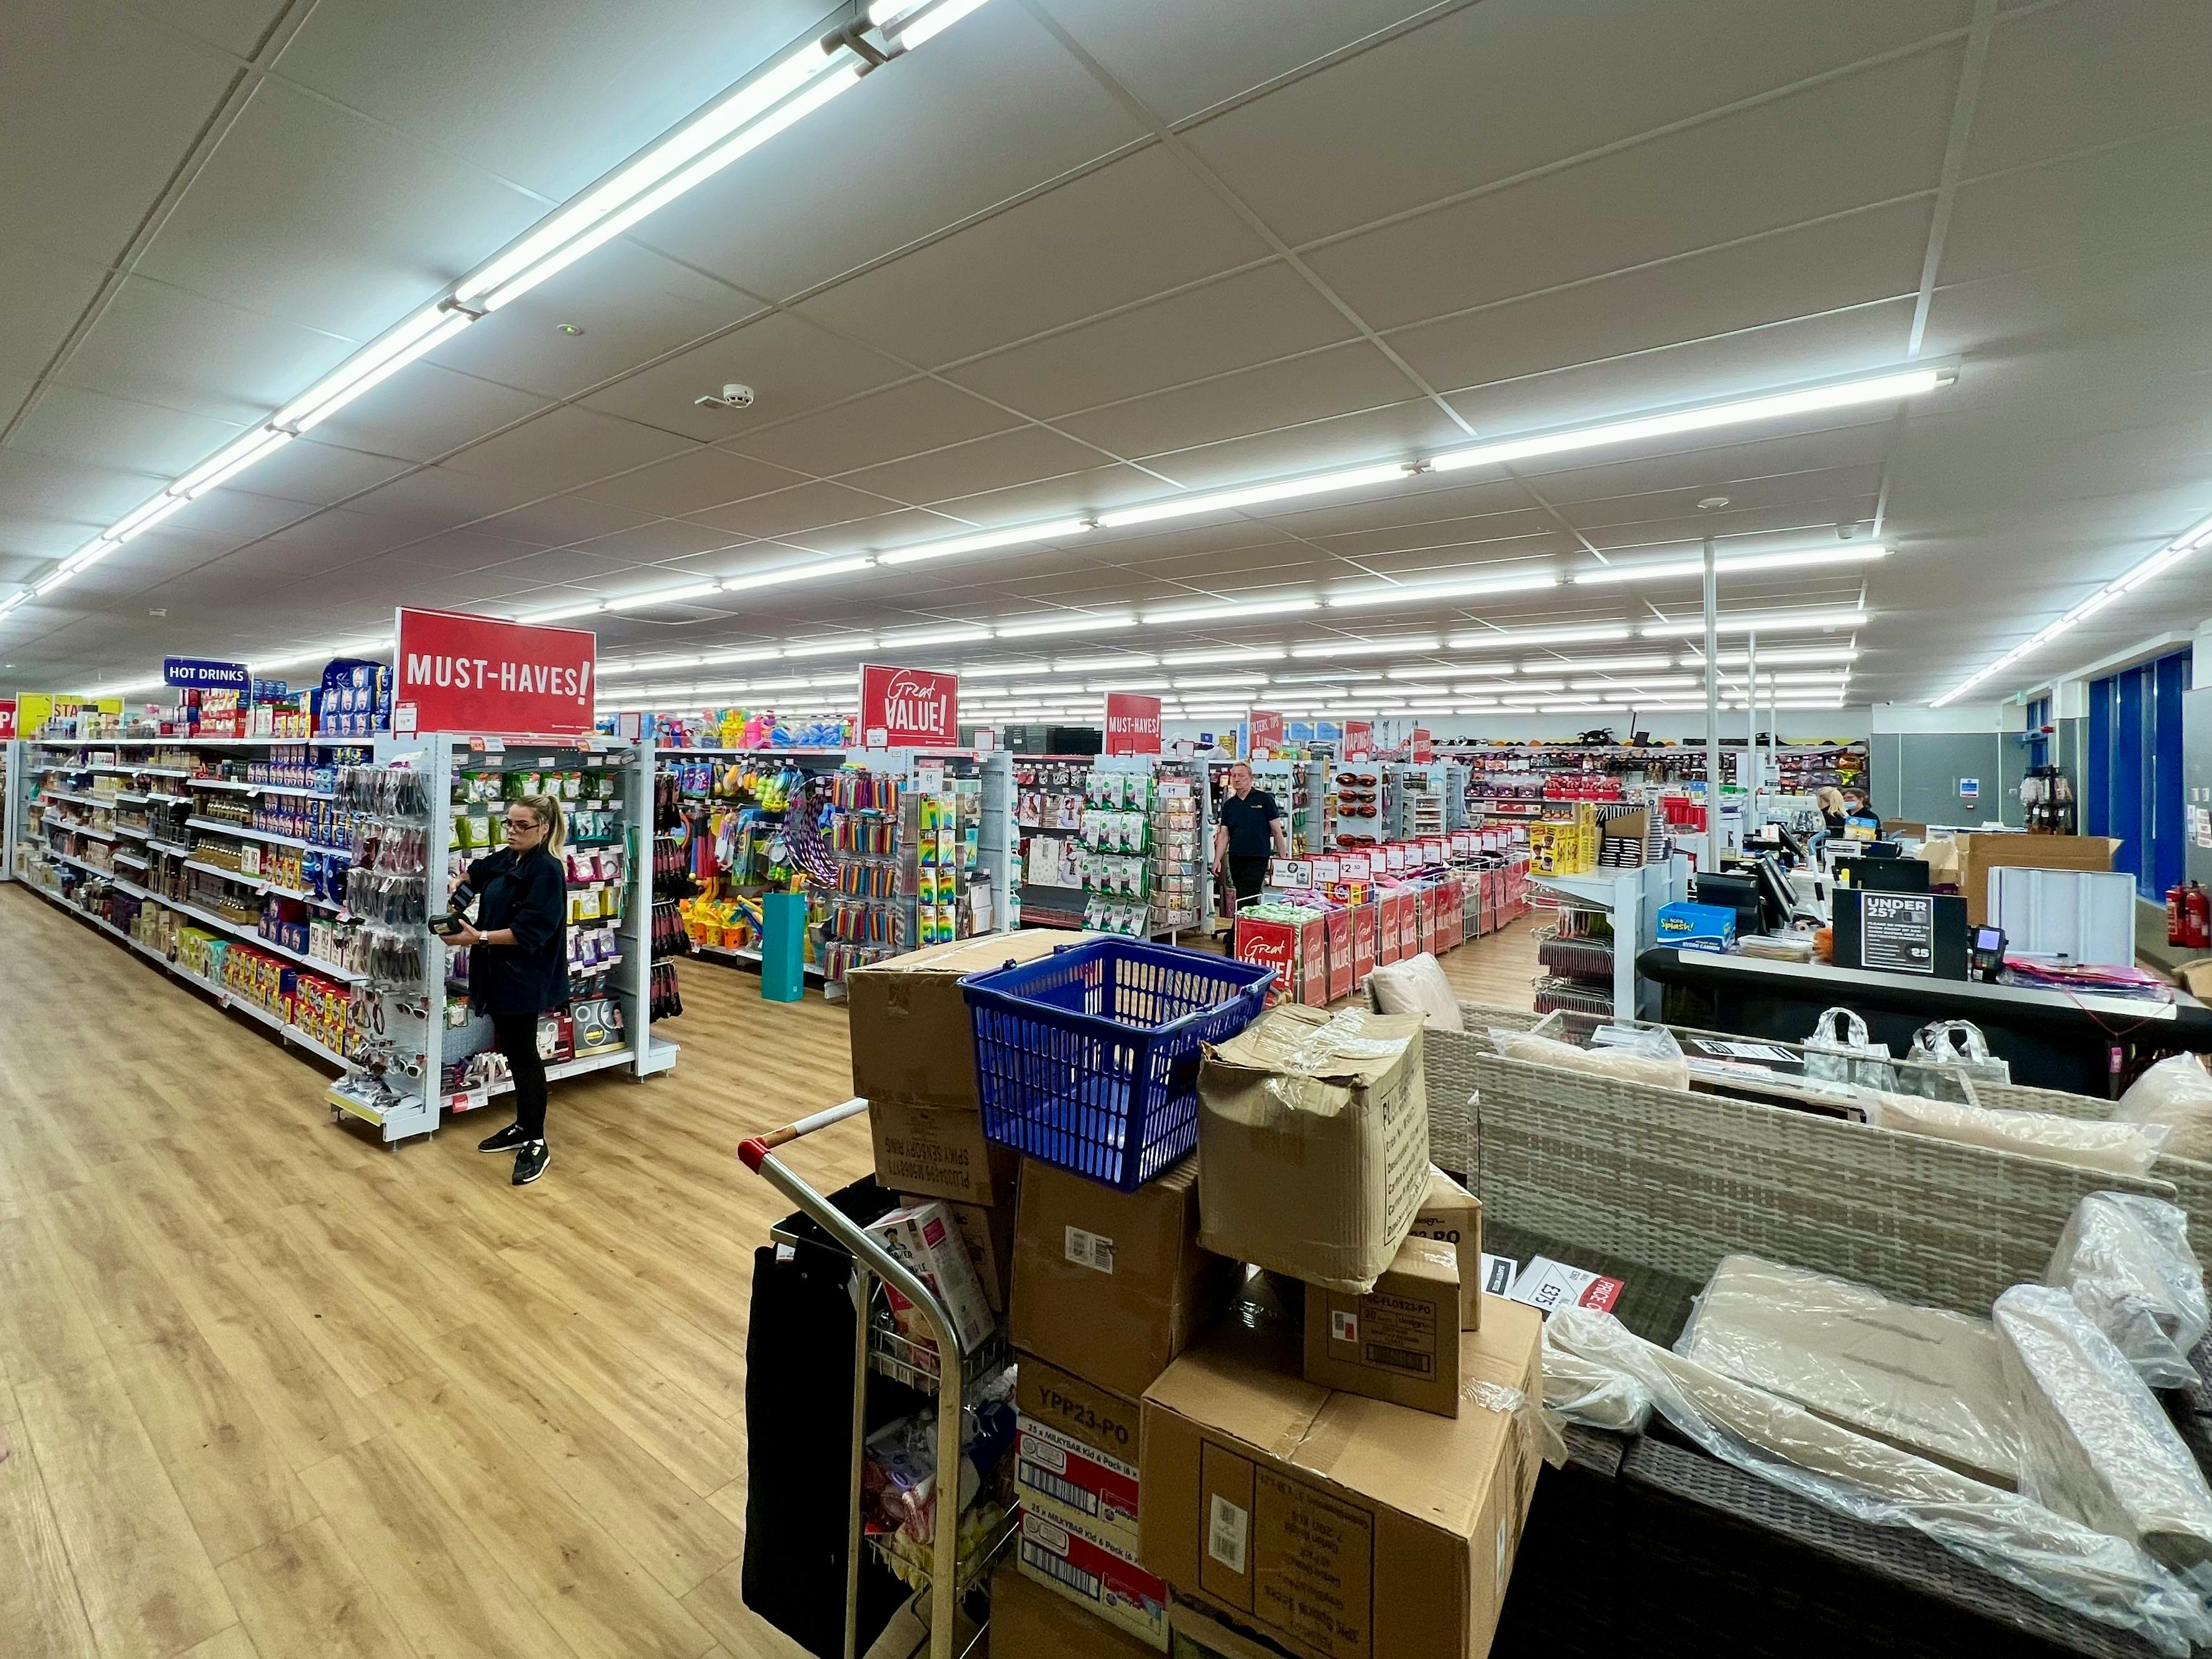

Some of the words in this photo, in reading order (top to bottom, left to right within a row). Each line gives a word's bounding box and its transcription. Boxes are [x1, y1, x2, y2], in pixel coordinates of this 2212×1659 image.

[170, 667, 196, 679] HOT
[199, 669, 244, 682] DRINKS
[407, 654, 590, 706] MUST-HAVES!
[887, 670, 936, 700] Great
[885, 694, 947, 736] VALUE!
[1109, 715, 1160, 738] MUST-HAVES!
[1346, 730, 1370, 752] VAPING!
[926, 774, 933, 785] £1
[1341, 864, 1351, 872] £2
[1867, 898, 1927, 912] UNDER
[1867, 907, 1896, 918] 25?
[1660, 918, 1694, 932] Splash!
[1244, 936, 1285, 957] Great
[1331, 942, 1351, 971] VALUE!
[1355, 935, 1374, 962] VALUE!
[1911, 948, 1929, 957] 25
[1305, 952, 1325, 982] VALUE!
[905, 1142, 943, 1161] SENSORY
[1535, 1284, 1561, 1305] £375
[1589, 1279, 1615, 1304] PRICE
[1038, 1384, 1130, 1445] YPP23-PO
[1028, 1424, 1037, 1433] 25
[1044, 1431, 1082, 1454] MILKYBAR
[1082, 1447, 1094, 1460] Kid
[1096, 1453, 1102, 1462] 6
[1103, 1456, 1122, 1471] Pack
[1031, 1503, 1040, 1514] 25
[1047, 1511, 1084, 1535] MILKYBAR
[1085, 1530, 1097, 1542] Kid
[1099, 1537, 1104, 1546] 6
[1105, 1540, 1124, 1556] Pack
